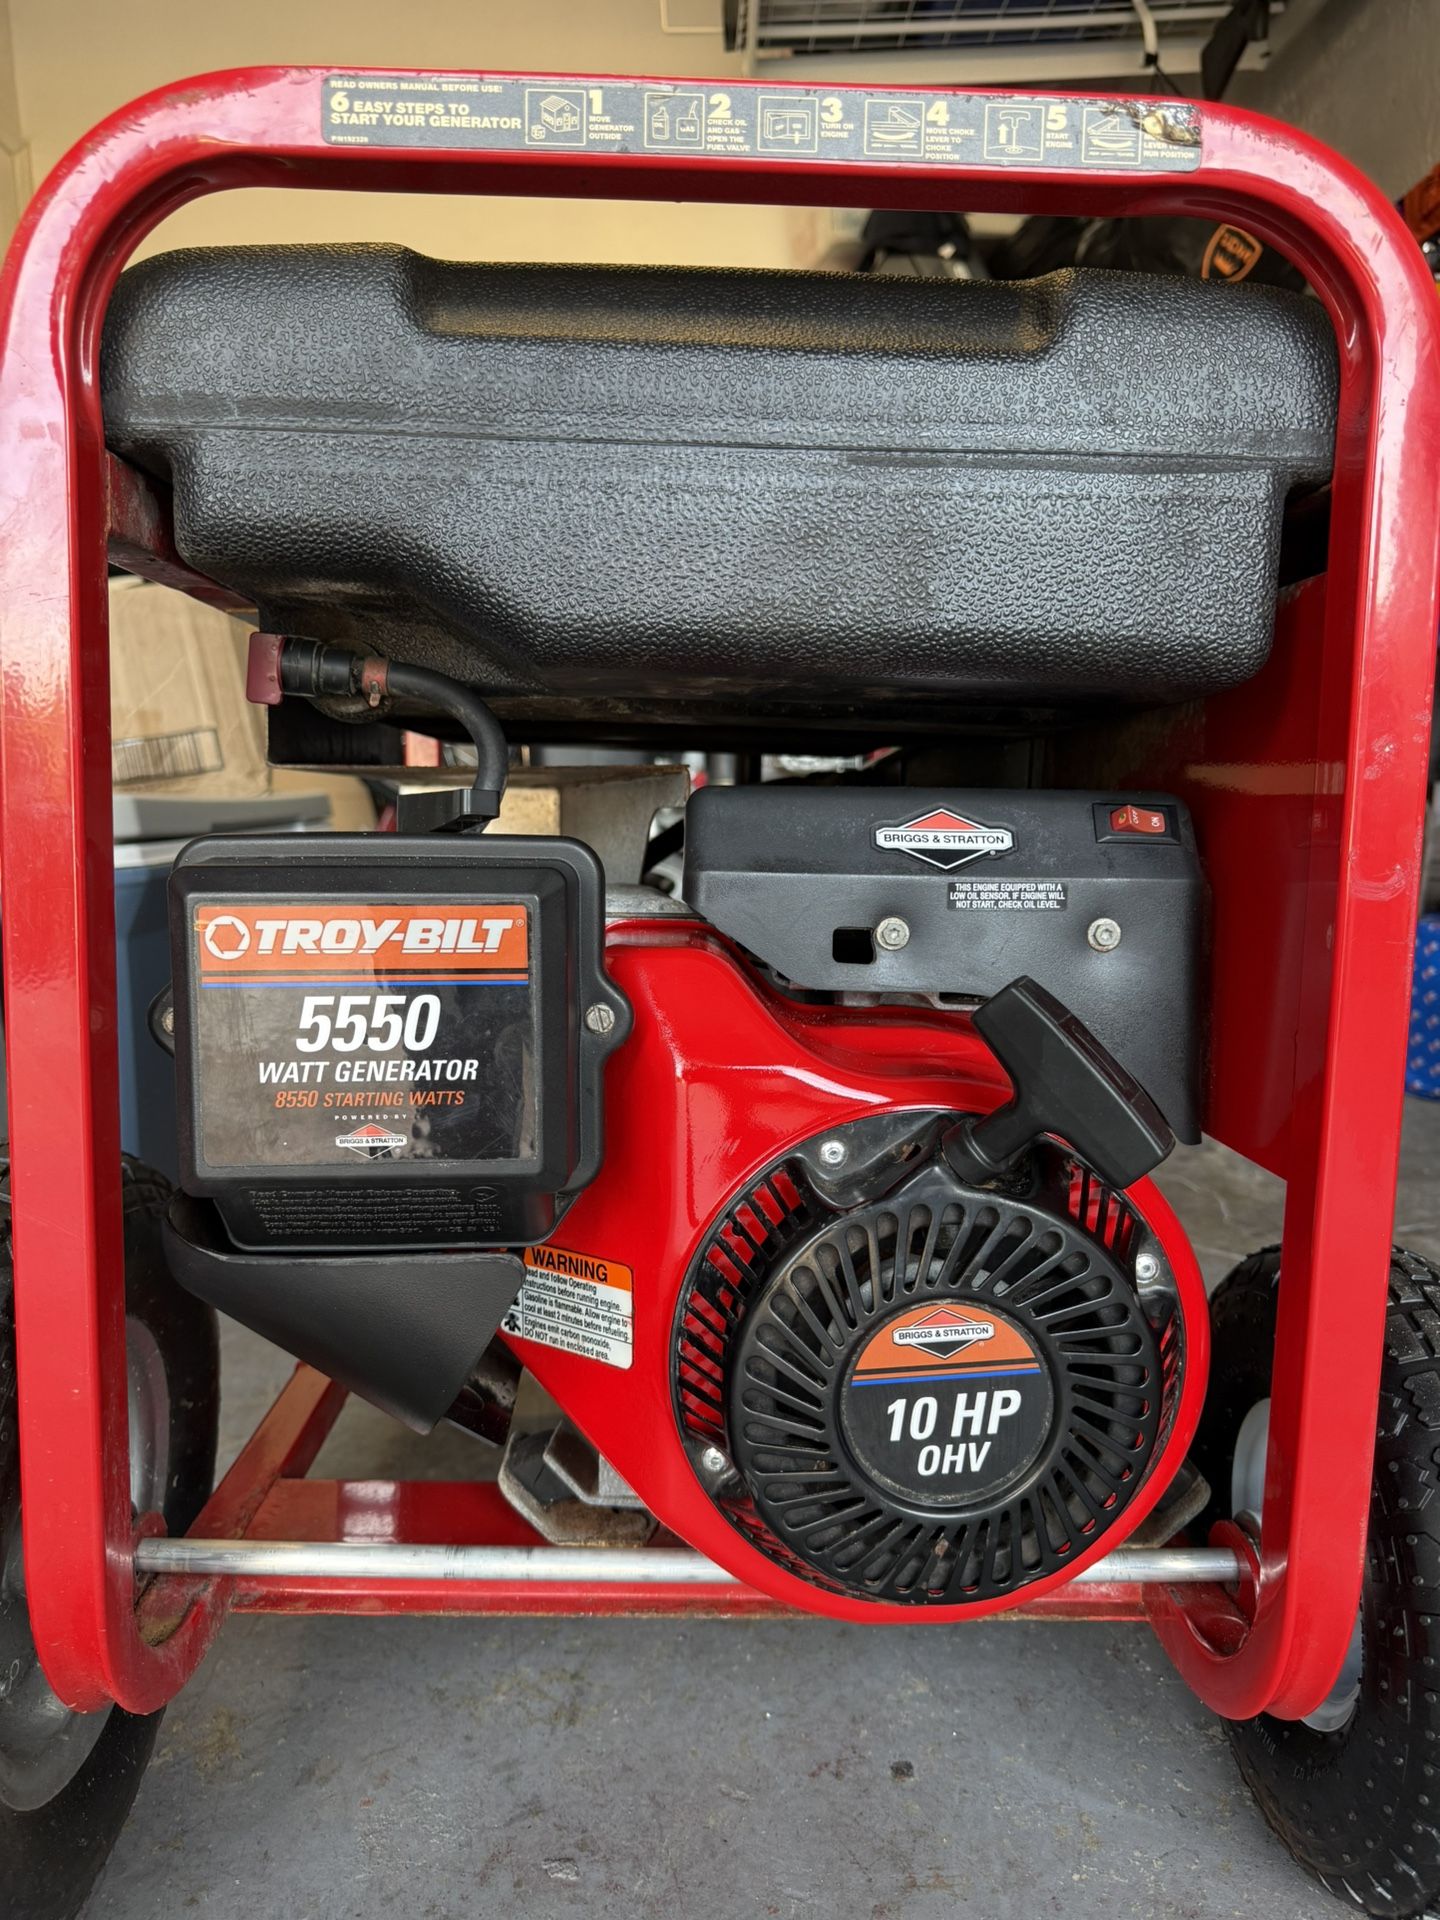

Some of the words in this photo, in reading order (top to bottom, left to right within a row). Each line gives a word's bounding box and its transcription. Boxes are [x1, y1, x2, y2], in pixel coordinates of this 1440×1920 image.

[330, 81, 355, 89] READ
[358, 82, 398, 90] OWNERS
[400, 82, 439, 91] MANUAL
[442, 83, 479, 92] BEFORE
[482, 85, 503, 93] USE!
[330, 91, 349, 112] 6
[353, 101, 393, 113] EASY
[396, 102, 444, 114] STEPS
[448, 104, 470, 115] TO
[589, 90, 602, 114] 1
[708, 93, 731, 118] 2
[821, 97, 843, 123] 3
[330, 113, 378, 125] START
[382, 114, 425, 126] YOUR
[429, 116, 521, 129] GENERATOR
[926, 101, 949, 126] 4
[1046, 106, 1067, 130] 5
[589, 124, 634, 132] GENERATOR
[821, 122, 840, 130] TURN
[821, 131, 849, 139] ENGINE
[926, 127, 946, 135] MOVE
[707, 135, 727, 143] OPEN
[926, 144, 952, 152] CHOKE
[950, 136, 961, 144] TO
[1046, 141, 1072, 149] ENGINE
[925, 153, 960, 161] POSITION
[1143, 150, 1159, 158] RUN
[1161, 151, 1194, 160] POSITION
[1151, 816, 1160, 827] ON
[883, 833, 929, 843] BRIGGS
[933, 834, 941, 843] &
[943, 834, 1004, 844] STRATTON
[955, 883, 971, 891] THIS
[973, 883, 999, 891] ENGINE
[1000, 883, 1036, 891] EQUIPPED
[1037, 883, 1055, 891] WITH
[1056, 883, 1062, 891] A
[972, 901, 997, 909] START,
[254, 919, 513, 954] TROY-BILT
[296, 994, 441, 1053] 5550
[258, 1061, 330, 1084] WATT
[334, 1060, 478, 1082] GENERATOR
[274, 1090, 317, 1109] 8550
[324, 1091, 403, 1107] STARTING
[408, 1090, 464, 1106] WATTS
[532, 1248, 608, 1283] WARNING
[527, 1268, 538, 1277] ead
[539, 1270, 550, 1280] and
[550, 1272, 568, 1285] follow
[568, 1277, 597, 1295] Operating
[524, 1291, 547, 1304] Gasoline
[549, 1297, 553, 1305] is
[554, 1298, 584, 1315] flammable.
[585, 1308, 600, 1320] Allow
[601, 1314, 621, 1326] engine
[622, 1318, 628, 1327] to
[557, 1286, 575, 1299] before
[576, 1292, 599, 1309] running
[600, 1299, 622, 1313] engine.
[524, 1302, 536, 1311] cool
[537, 1306, 543, 1314] at
[543, 1307, 556, 1318] least
[557, 1311, 560, 1320] 2
[561, 1313, 583, 1326] minutes
[584, 1319, 602, 1332] before
[602, 1324, 630, 1341] refueling.
[524, 1316, 546, 1331] Engines
[547, 1324, 559, 1334] emit
[560, 1327, 580, 1340] carbon
[581, 1335, 611, 1351] monoxide,
[524, 1327, 534, 1337] DO
[535, 1331, 548, 1342] NOT
[549, 1336, 559, 1345] run
[560, 1337, 565, 1347] in
[567, 1341, 594, 1356] enclosed
[595, 1349, 609, 1360] area.
[899, 1330, 932, 1340] BRIGGS
[943, 1327, 989, 1337] STRATTON
[887, 1396, 938, 1441] 10
[951, 1390, 1022, 1437] HP
[917, 1441, 991, 1476] OHV
